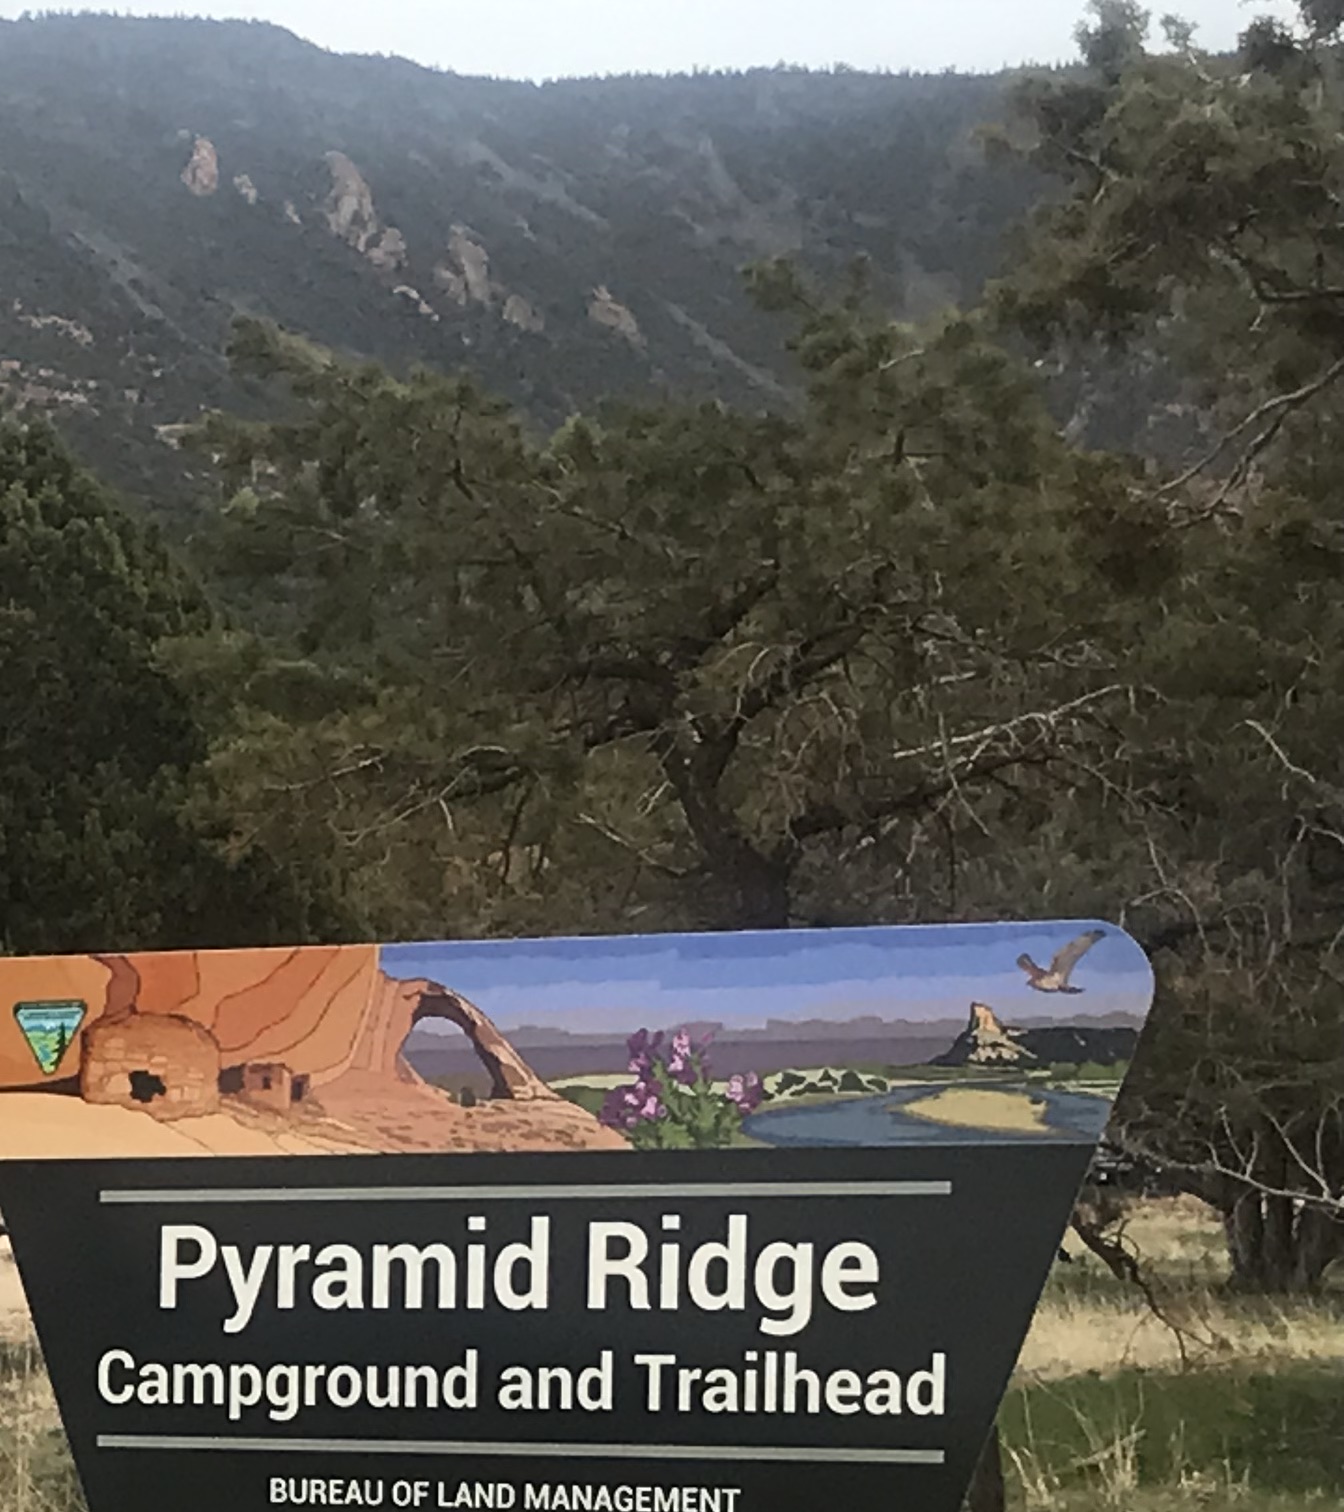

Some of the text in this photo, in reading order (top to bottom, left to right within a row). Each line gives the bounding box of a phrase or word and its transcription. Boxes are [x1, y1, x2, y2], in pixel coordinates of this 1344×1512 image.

[159, 1214, 880, 1337] Pyramid Ridge
[97, 1348, 946, 1422] Campground and Trailhead
[269, 1477, 384, 1507] BUREAU
[390, 1479, 430, 1507] OF
[437, 1481, 516, 1509] LAND
